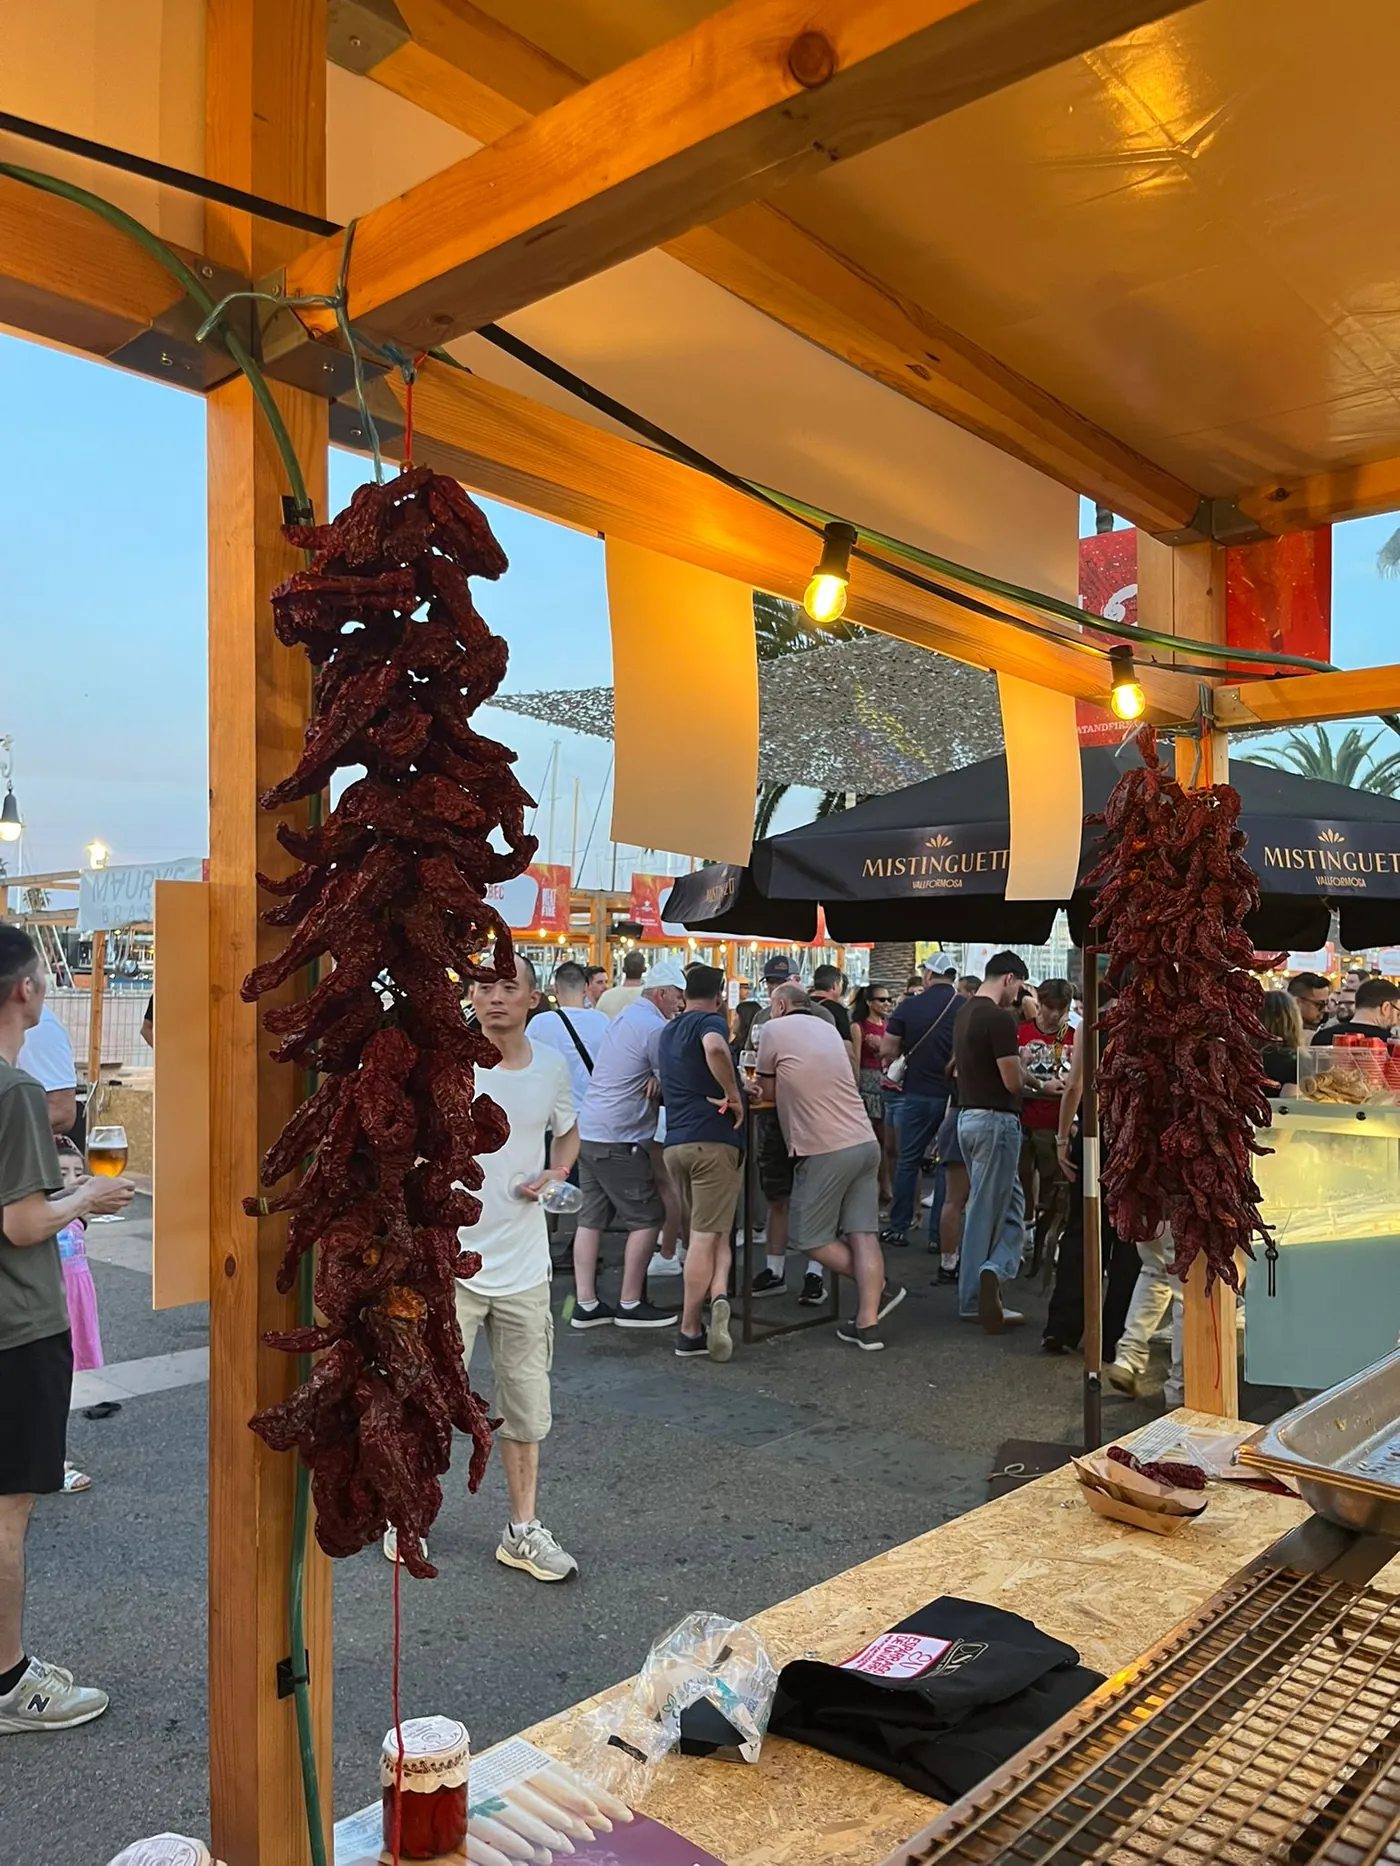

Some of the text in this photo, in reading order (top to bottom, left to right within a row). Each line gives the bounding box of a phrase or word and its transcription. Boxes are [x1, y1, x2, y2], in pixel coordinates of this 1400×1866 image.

[862, 850, 1009, 877] MISTINGUETT
[1264, 846, 1400, 873] MISTINGUET
[912, 879, 963, 889] VALLFORMOSA
[1315, 875, 1367, 888] VALLFORMOSA
[27, 1694, 50, 1712] N
